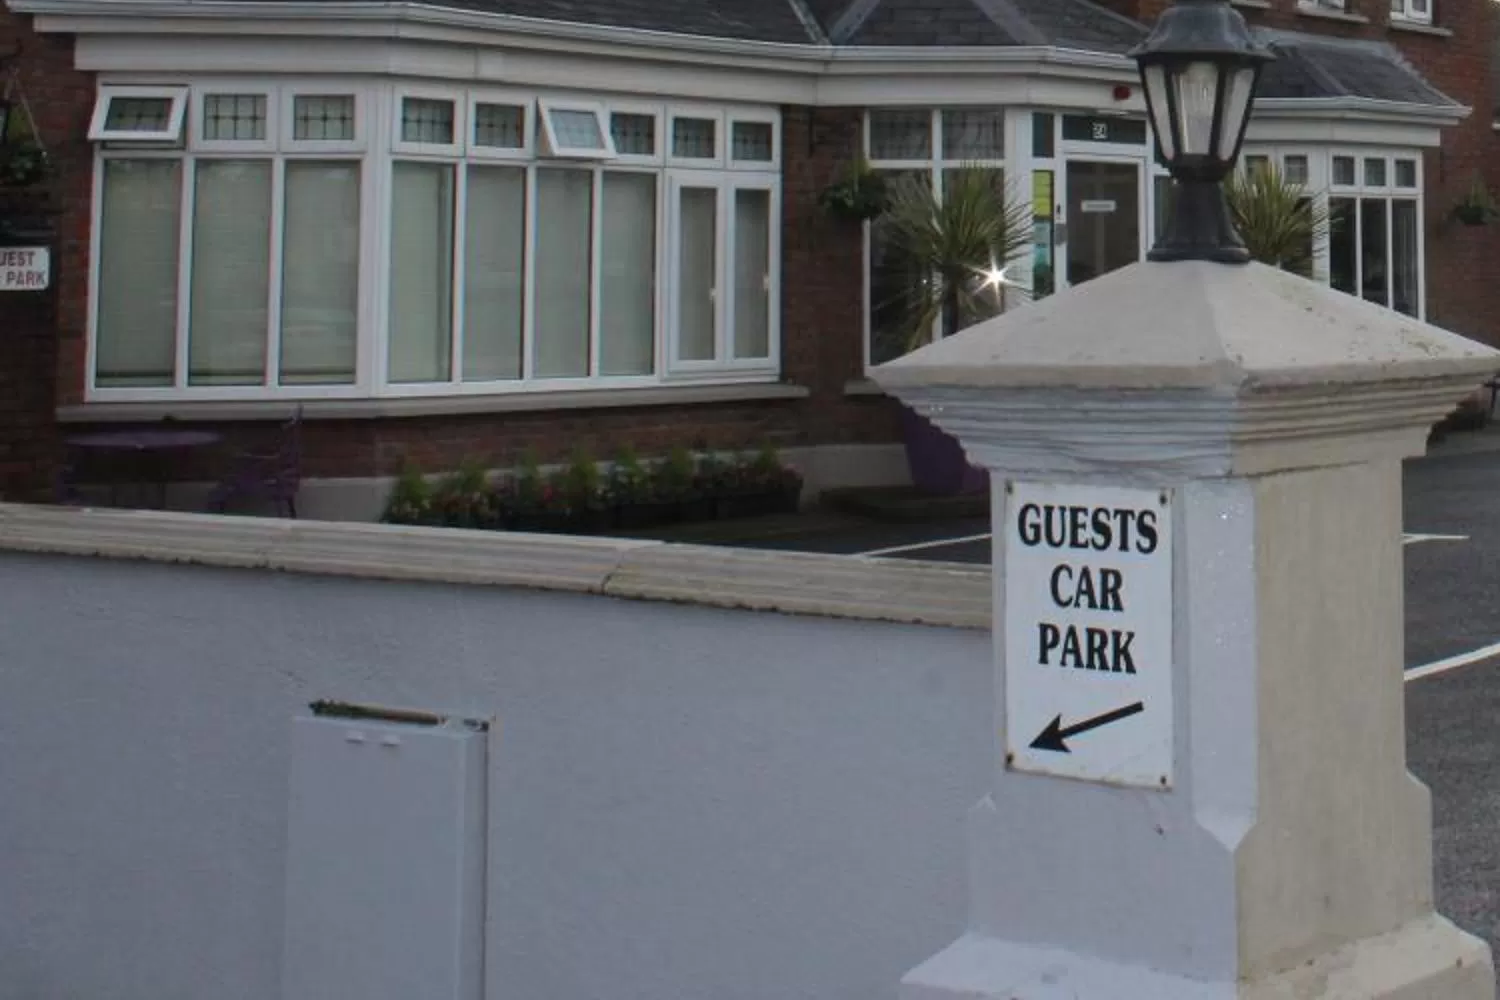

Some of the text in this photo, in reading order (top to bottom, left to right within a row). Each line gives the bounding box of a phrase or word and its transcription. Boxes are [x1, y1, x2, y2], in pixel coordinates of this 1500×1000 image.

[6, 270, 45, 286] PARK
[1018, 503, 1159, 554] GUESTS
[1050, 564, 1124, 612] CAR
[1038, 622, 1137, 675] PARK
